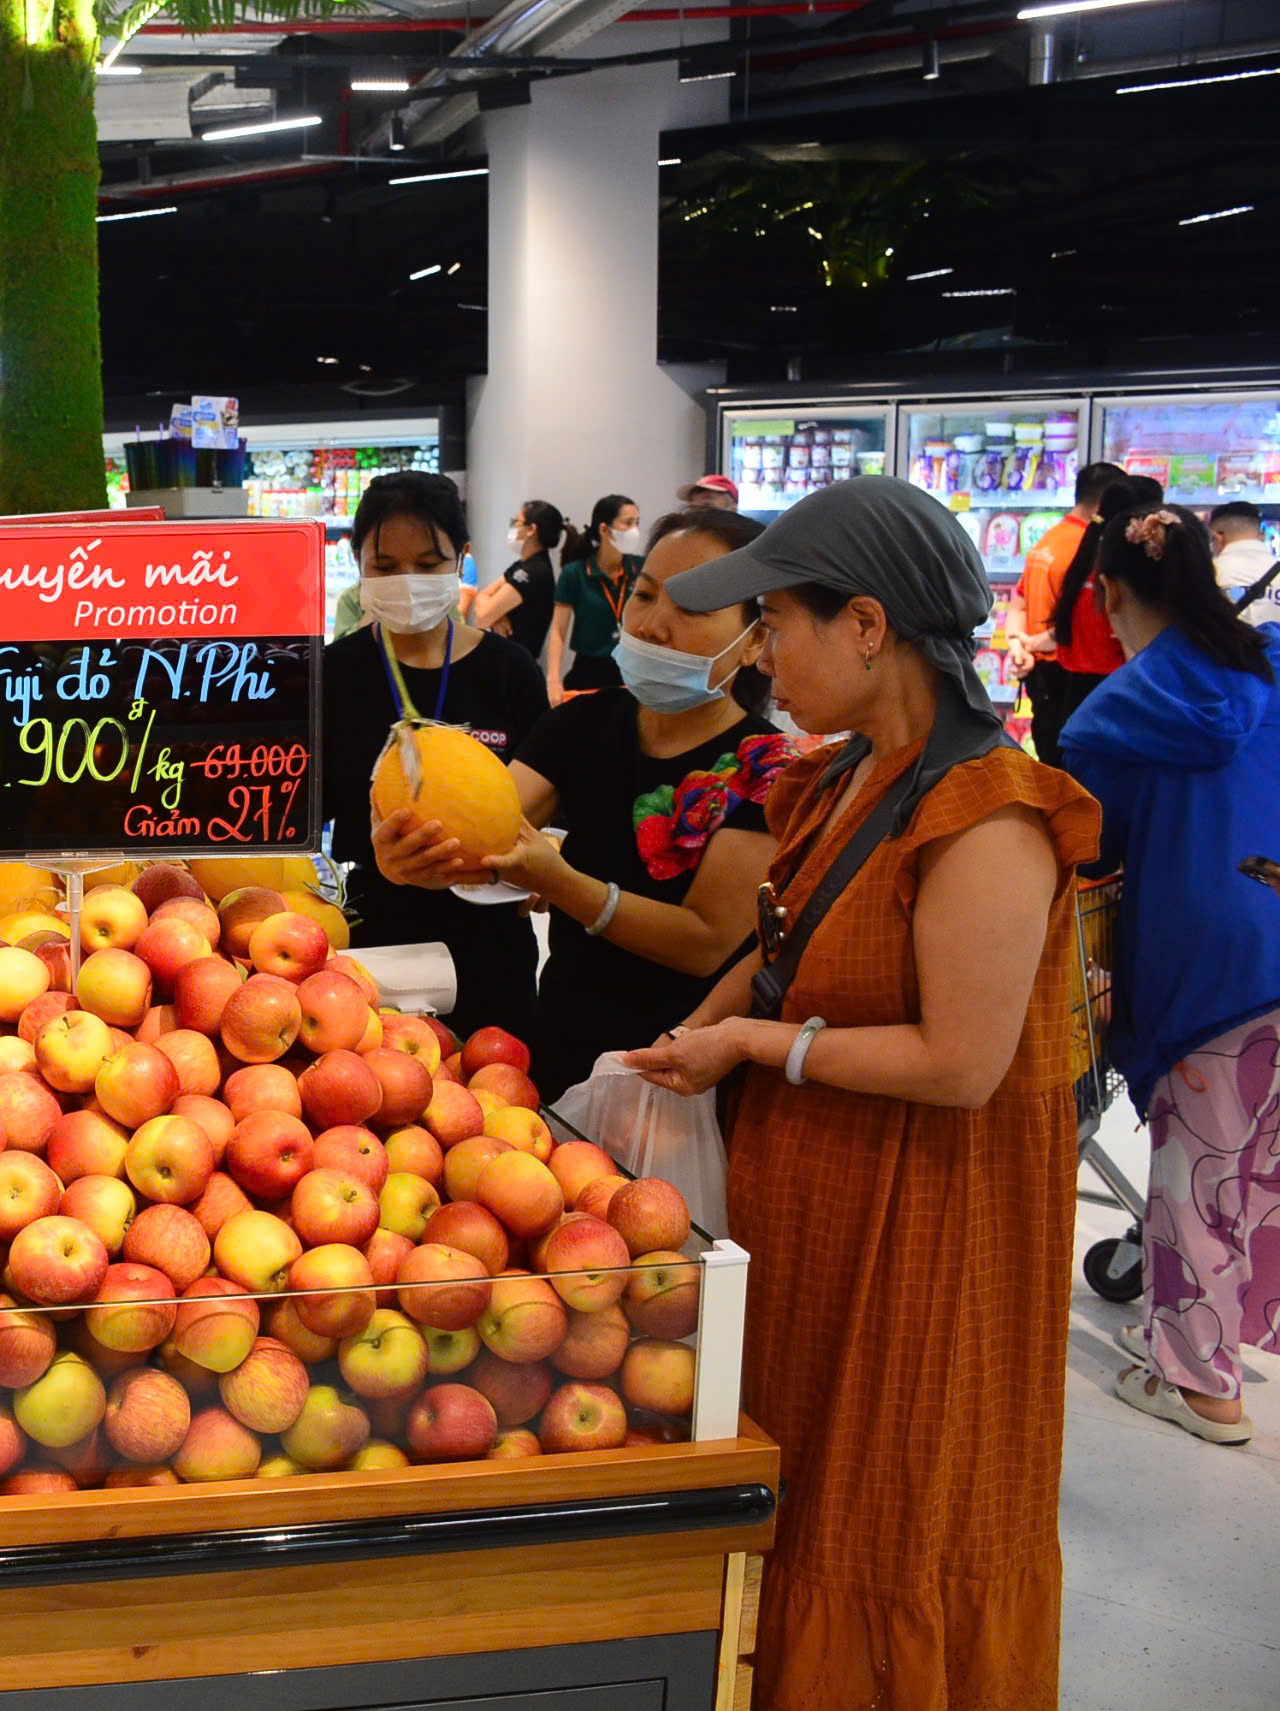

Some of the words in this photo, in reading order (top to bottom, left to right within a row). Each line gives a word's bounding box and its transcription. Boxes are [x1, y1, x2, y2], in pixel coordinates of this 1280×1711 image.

[145, 551, 239, 588] mãi
[74, 597, 238, 627] Promotion
[56, 646, 118, 701] đỏ
[191, 744, 311, 780] 69.000
[125, 811, 200, 838] Giảm
[207, 778, 301, 842] 27%
